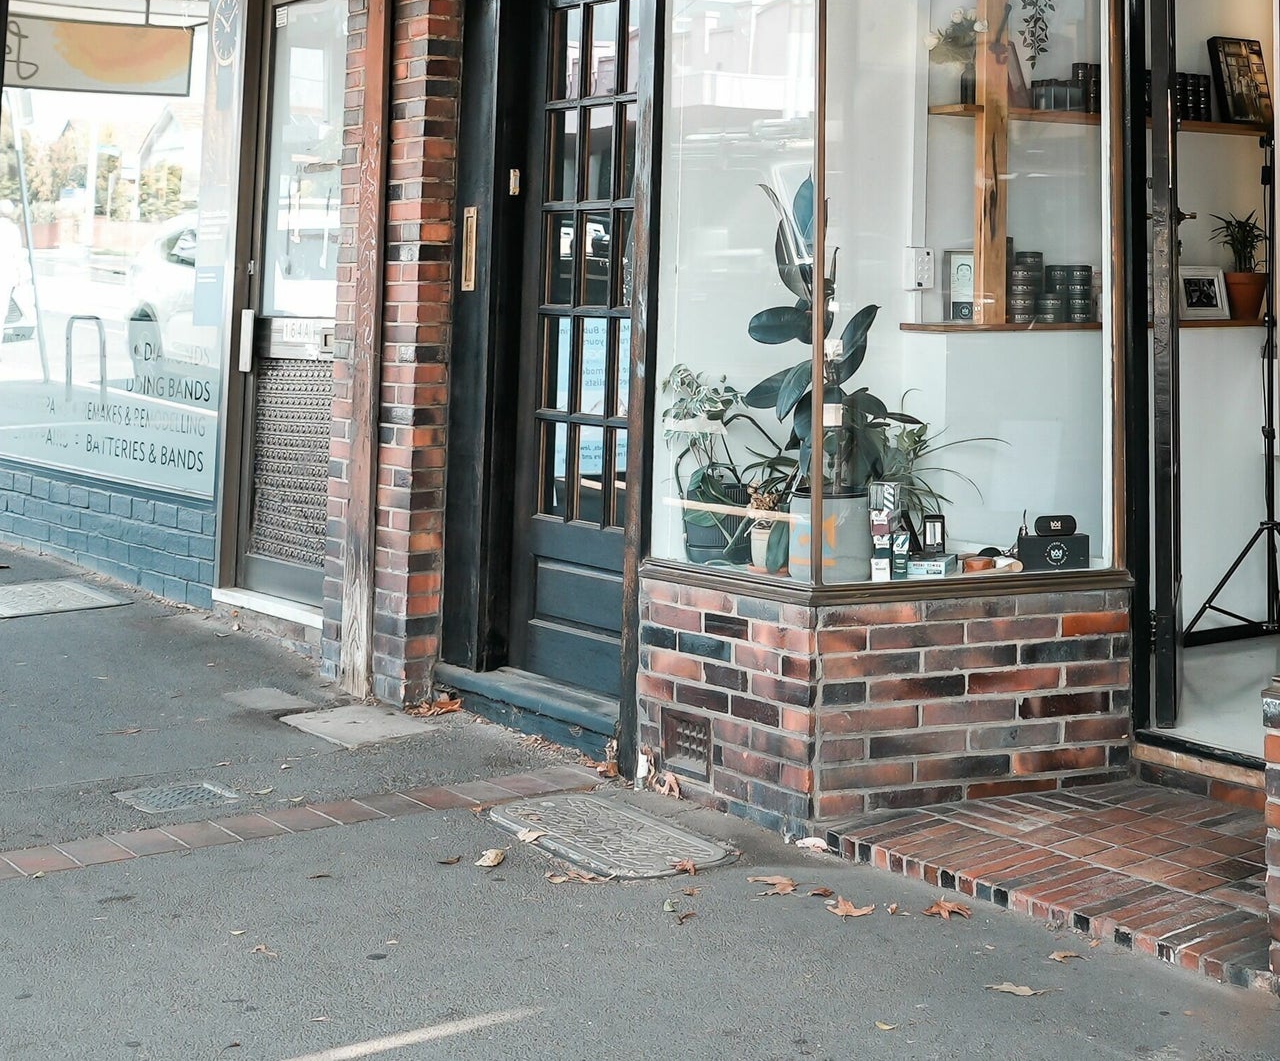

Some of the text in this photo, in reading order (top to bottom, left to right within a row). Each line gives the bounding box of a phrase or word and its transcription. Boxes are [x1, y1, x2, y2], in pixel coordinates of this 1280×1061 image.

[168, 377, 211, 402] BANDS
[125, 405, 132, 427] &
[86, 433, 144, 462] BATTERIES
[148, 442, 157, 464] &
[160, 445, 204, 472] BANDS
